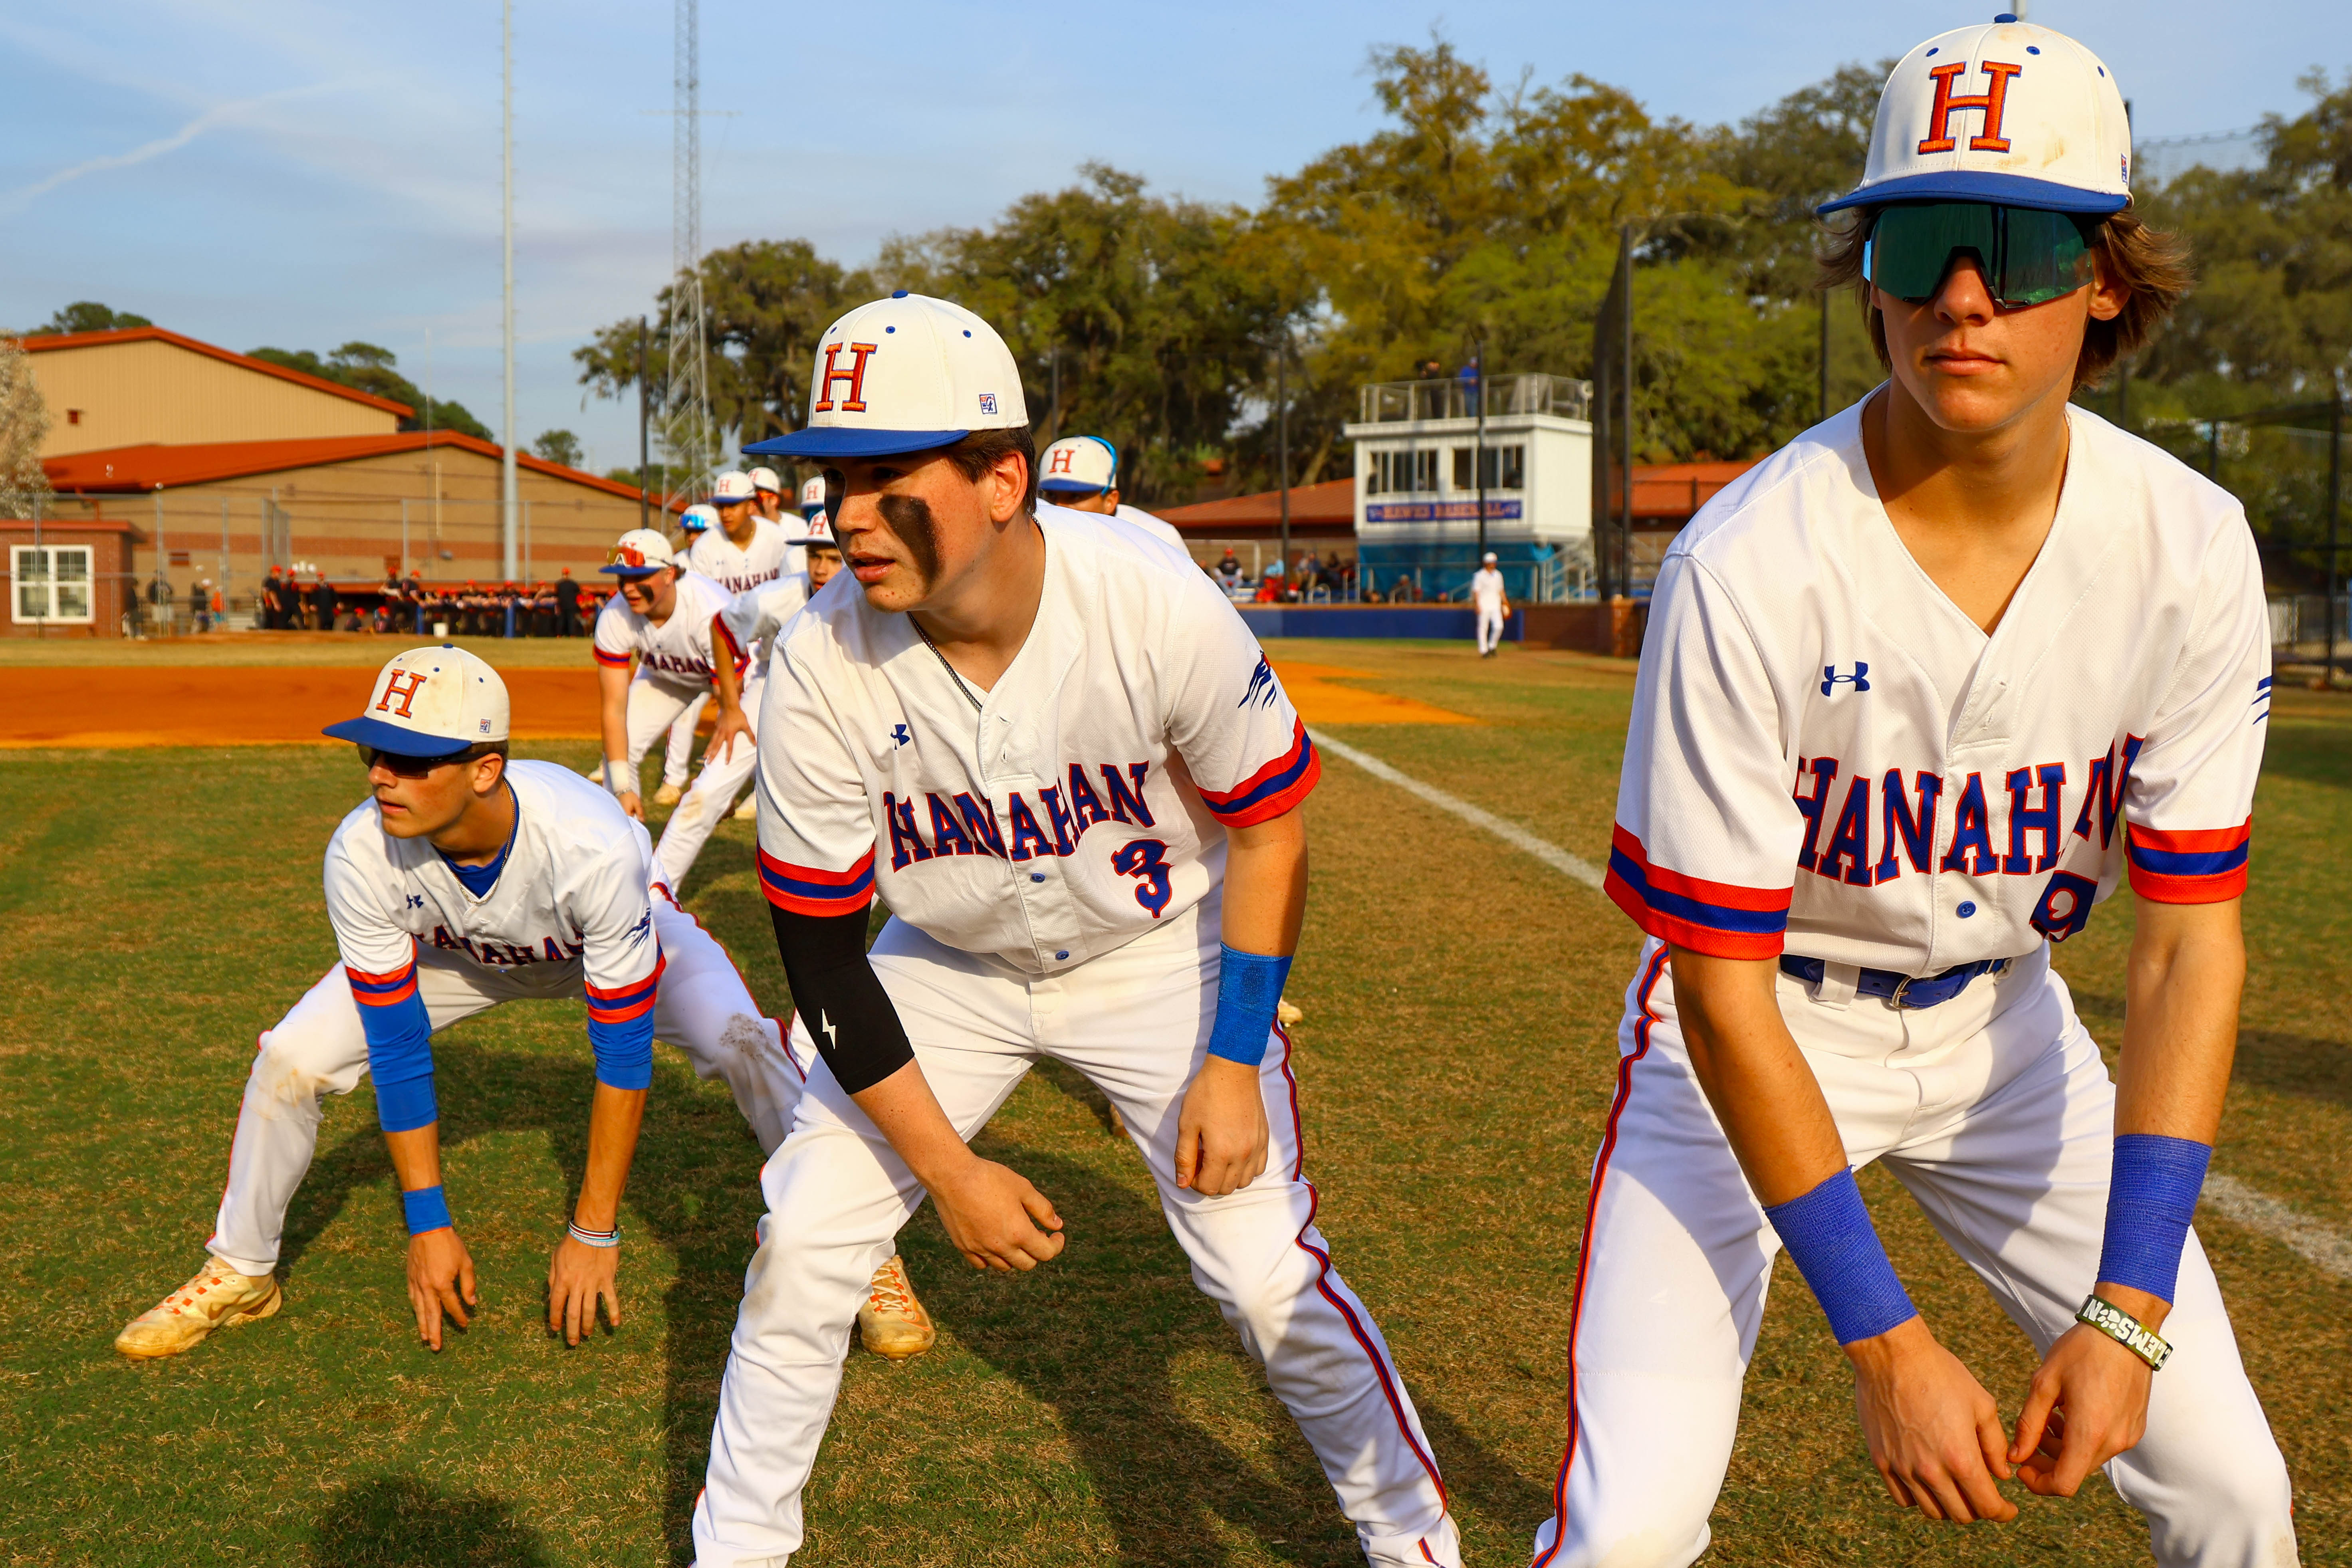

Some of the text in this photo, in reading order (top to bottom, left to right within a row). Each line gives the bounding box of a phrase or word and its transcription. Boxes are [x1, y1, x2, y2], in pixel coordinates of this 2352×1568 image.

[1918, 60, 2023, 155] H
[815, 341, 878, 413] H
[718, 479, 731, 492] H
[1049, 448, 1075, 473] H
[806, 485, 818, 500] H
[1435, 503, 1505, 518] BASEBLL
[808, 515, 827, 535] H
[375, 668, 427, 719] H
[883, 759, 1156, 873] HANAHAN
[1793, 732, 2145, 887] HANAHN
[1110, 839, 1175, 919] 3
